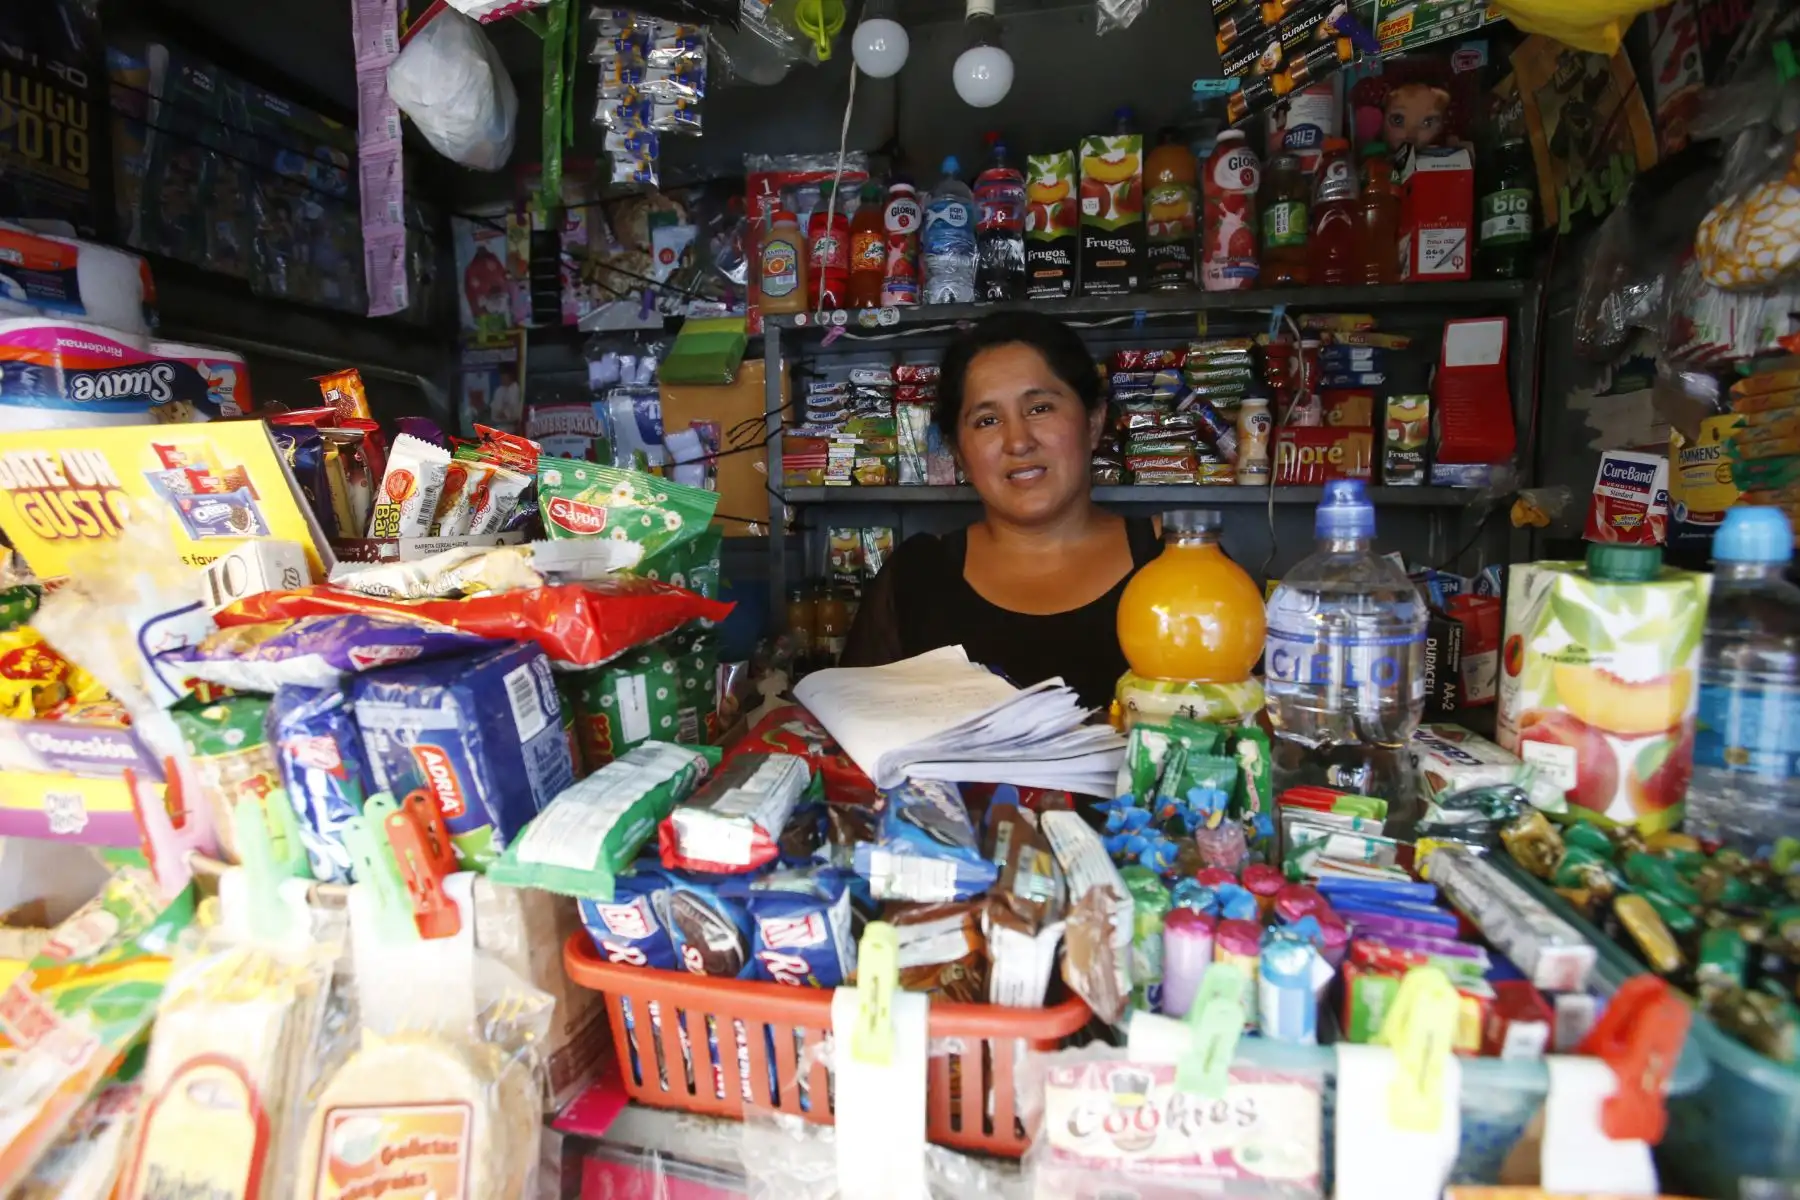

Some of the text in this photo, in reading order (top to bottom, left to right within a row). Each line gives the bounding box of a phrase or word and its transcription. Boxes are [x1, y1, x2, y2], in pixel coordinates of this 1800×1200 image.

[1281, 13, 1324, 41] DURACELL
[1224, 50, 1261, 76] DURACELL
[1285, 129, 1316, 147] Elite
[891, 204, 916, 219] GLORIA
[1493, 194, 1528, 213] bio
[1086, 237, 1130, 250] Frugos
[1027, 249, 1066, 262] Frugos
[56, 338, 123, 358] Rindemax
[73, 365, 175, 402] Suave
[1112, 374, 1131, 385] SODA
[1278, 440, 1343, 465] Doré
[1679, 446, 1721, 465] AMMENS
[58, 448, 121, 488] UN
[1603, 462, 1656, 484] CureBand
[1606, 480, 1642, 492] VENDITAS
[1610, 489, 1634, 499] Standard
[552, 503, 601, 527] Sayon
[414, 542, 435, 550] BARRITA
[1272, 648, 1398, 689] CIELO
[1425, 637, 1438, 695] DURACELL
[421, 751, 461, 813] ADRIA
